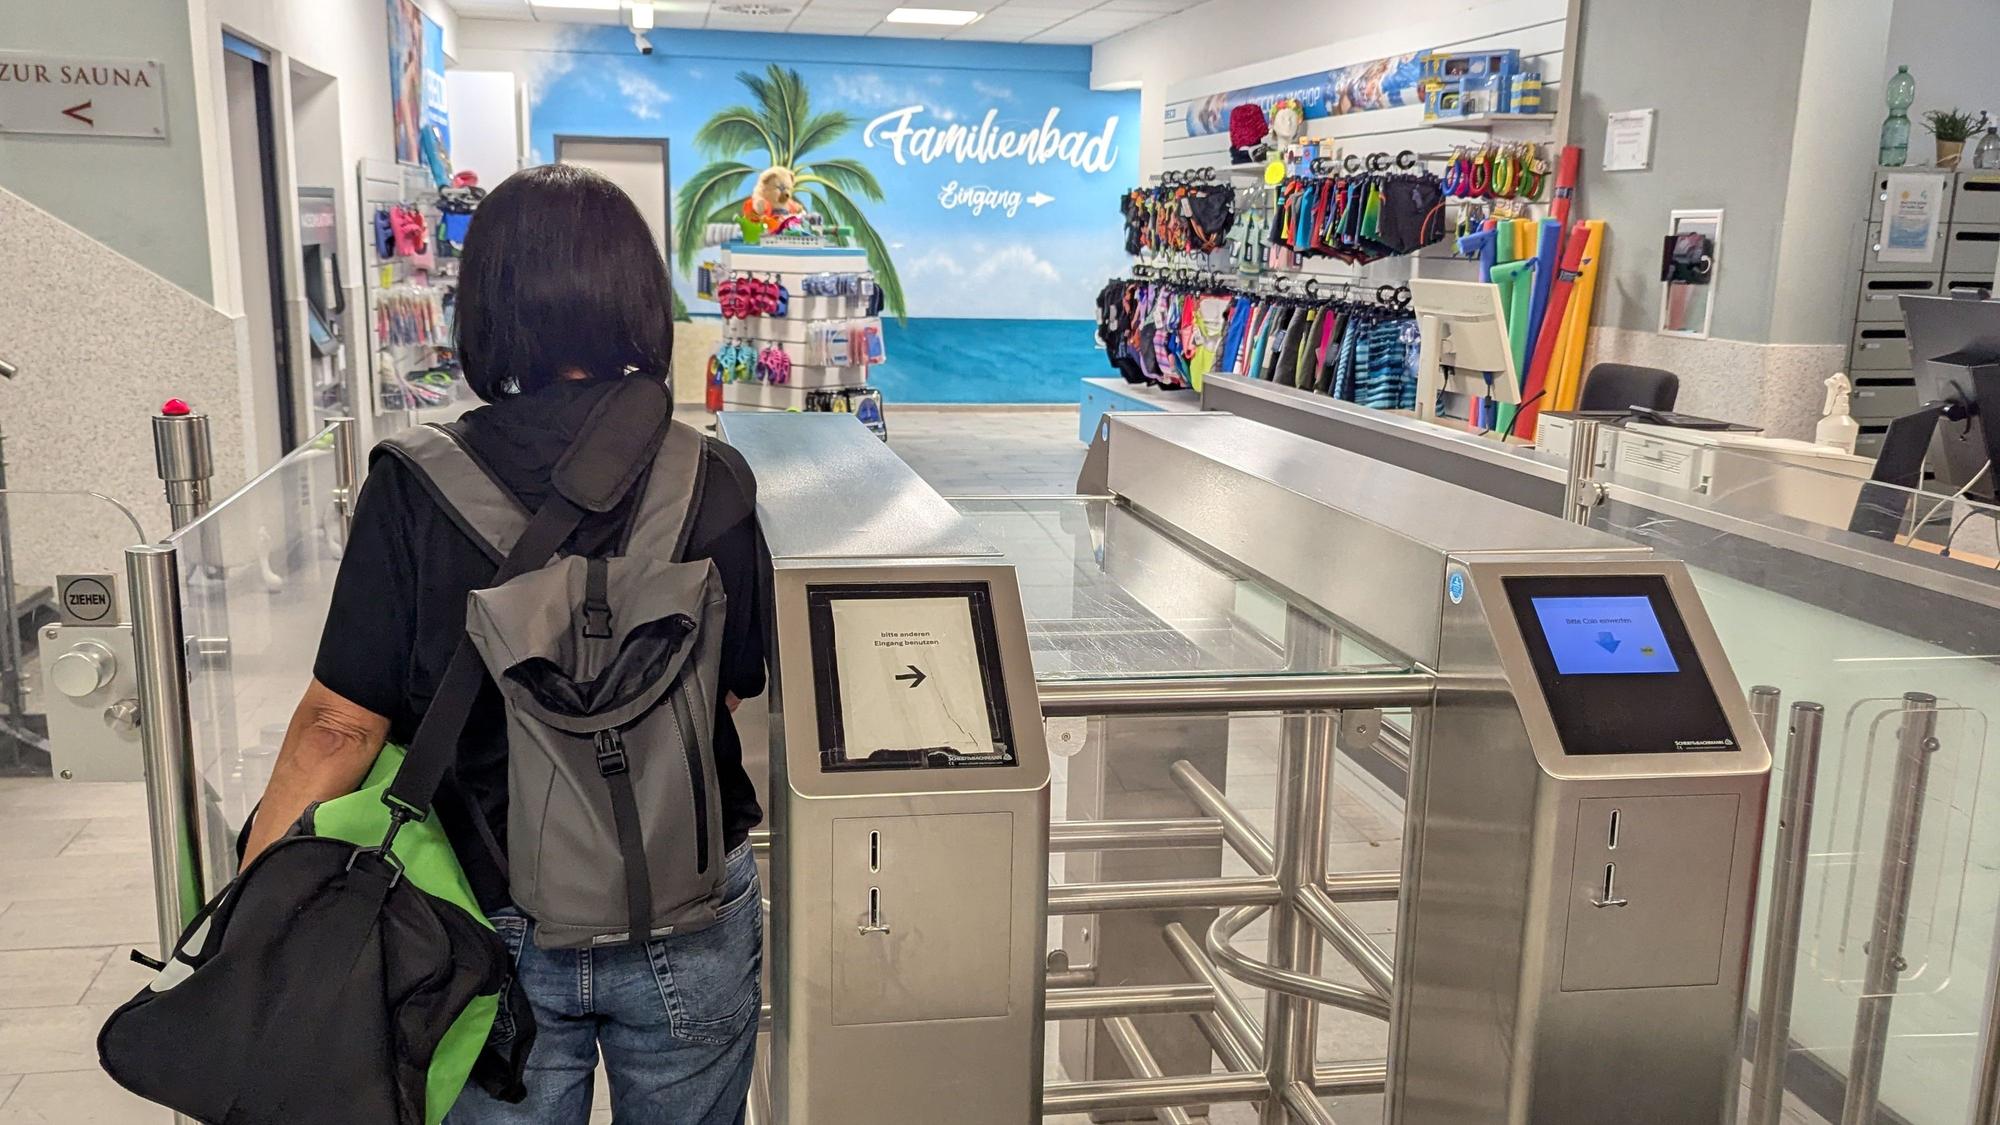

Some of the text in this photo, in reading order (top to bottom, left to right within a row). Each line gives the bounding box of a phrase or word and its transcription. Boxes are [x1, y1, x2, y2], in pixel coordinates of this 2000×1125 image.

[0, 63, 151, 88] ZUR SAUNA
[863, 105, 1119, 173] Familienbad
[938, 180, 1023, 218] Eingang
[69, 594, 106, 605] ZIEHEN
